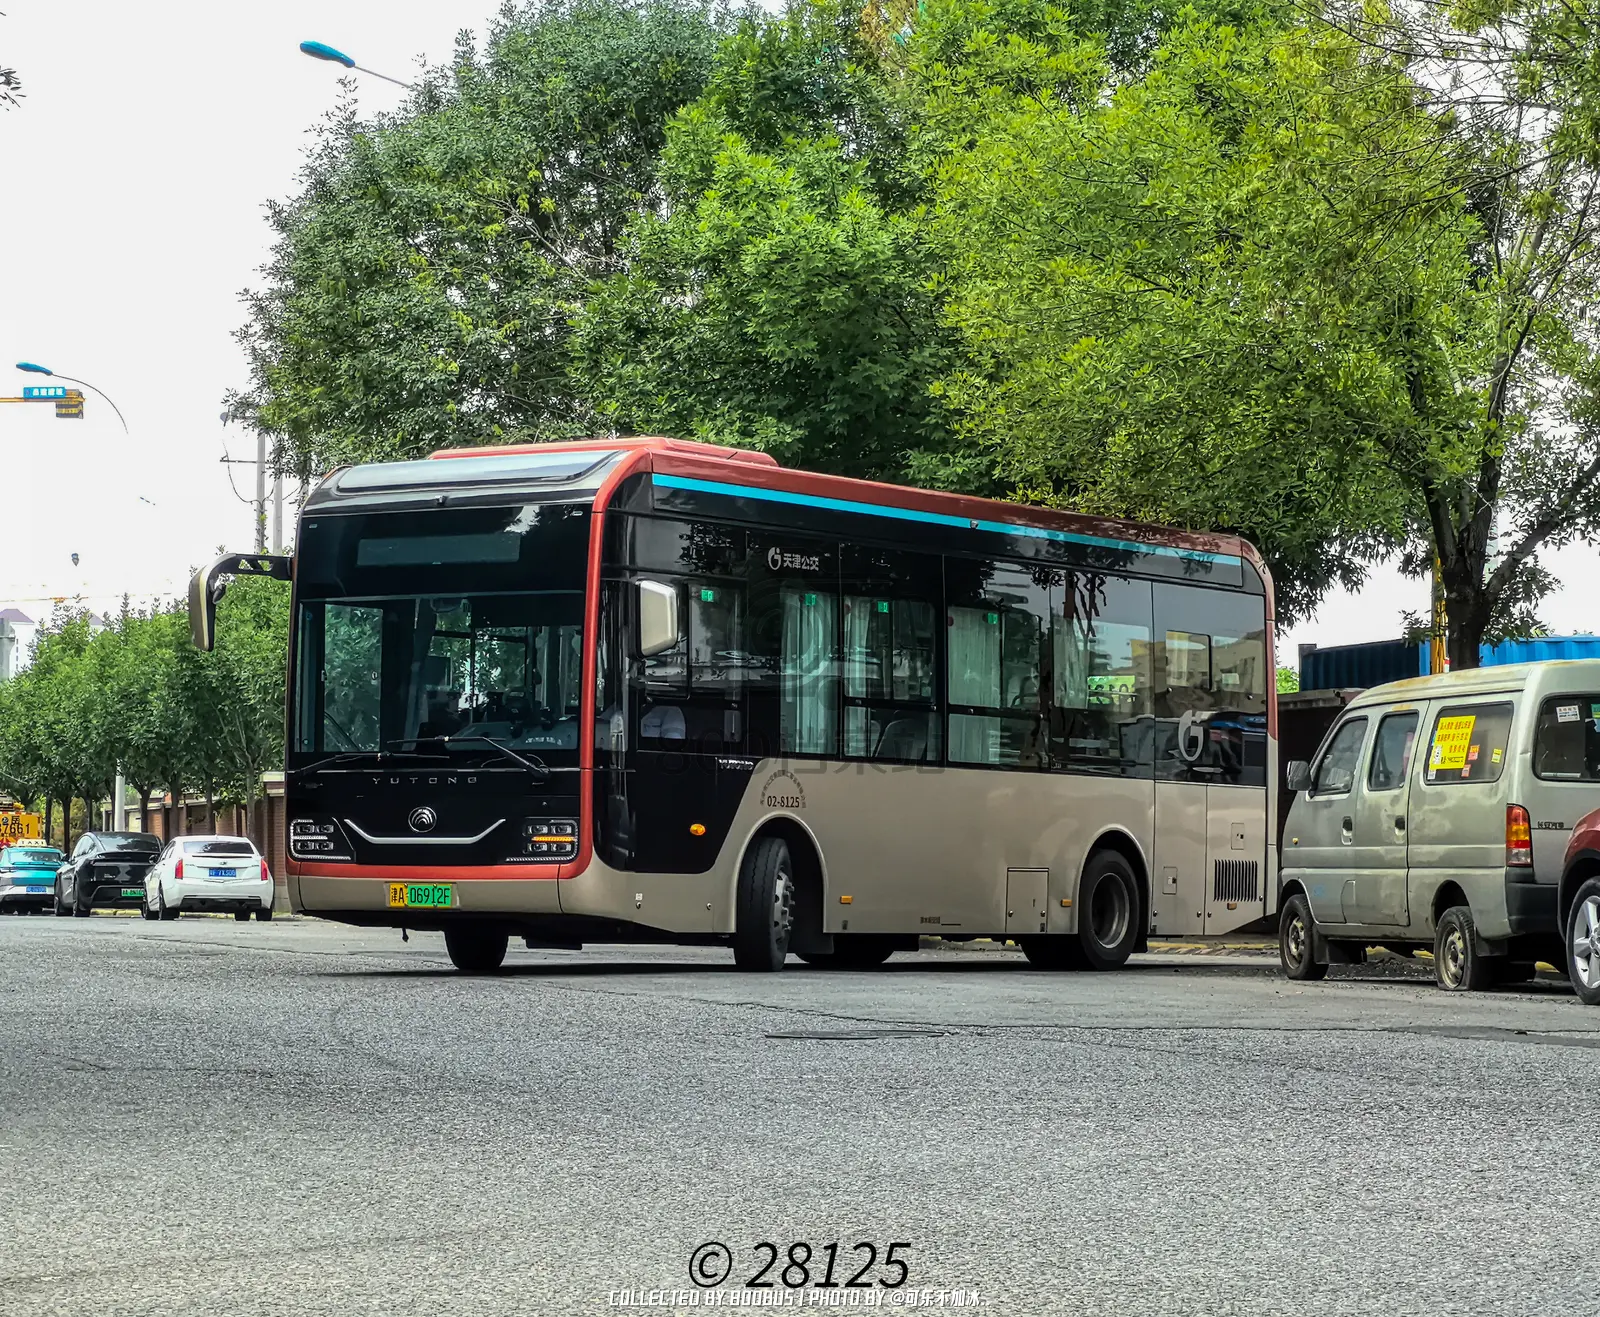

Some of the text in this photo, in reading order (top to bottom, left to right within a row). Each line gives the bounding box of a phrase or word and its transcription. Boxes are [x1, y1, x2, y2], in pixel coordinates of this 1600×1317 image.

[783, 553, 819, 571] 天津公交
[372, 776, 477, 785] YUTONG
[766, 795, 800, 808] 02-8125
[0, 823, 30, 834] 7661
